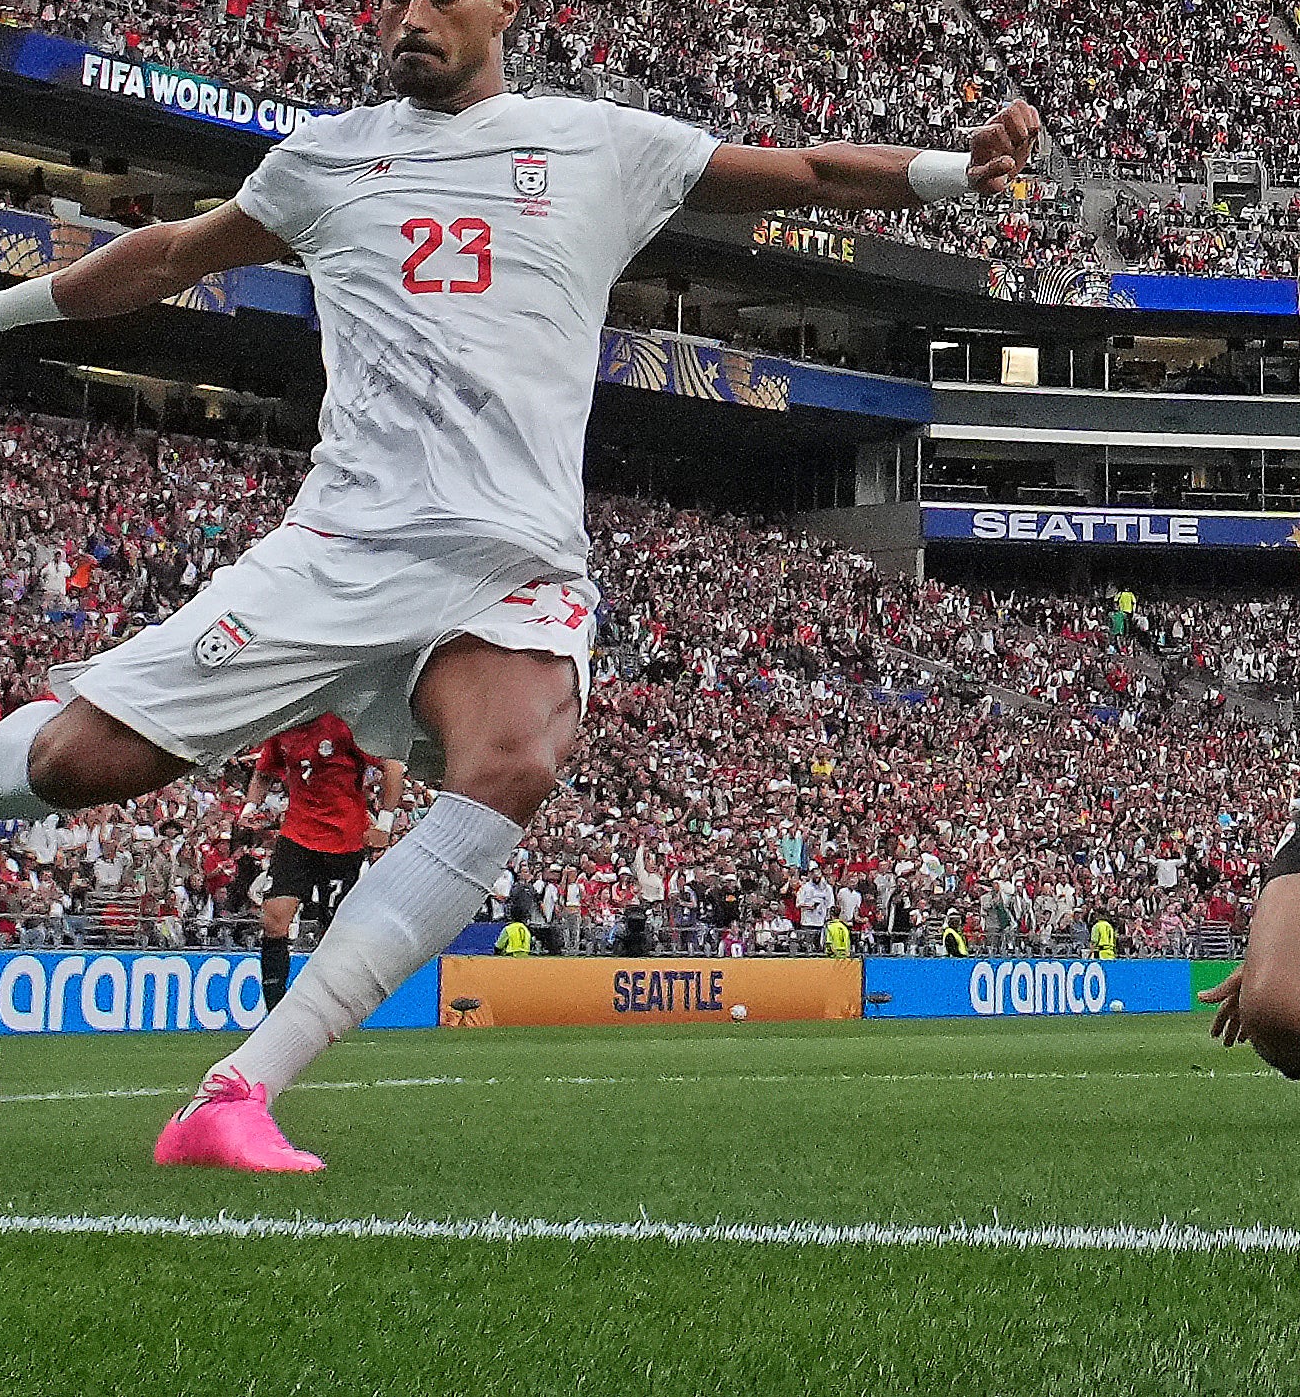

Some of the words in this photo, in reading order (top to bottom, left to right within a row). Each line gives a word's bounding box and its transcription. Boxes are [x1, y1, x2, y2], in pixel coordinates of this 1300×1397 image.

[82, 53, 146, 98] FIFA
[150, 69, 254, 124] WORLD
[400, 217, 493, 295] 23
[753, 218, 856, 263] SEATTLE
[972, 511, 1200, 544] SEATTLE
[612, 969, 724, 1013] SEATTLE
[969, 961, 1106, 1015] aramco
